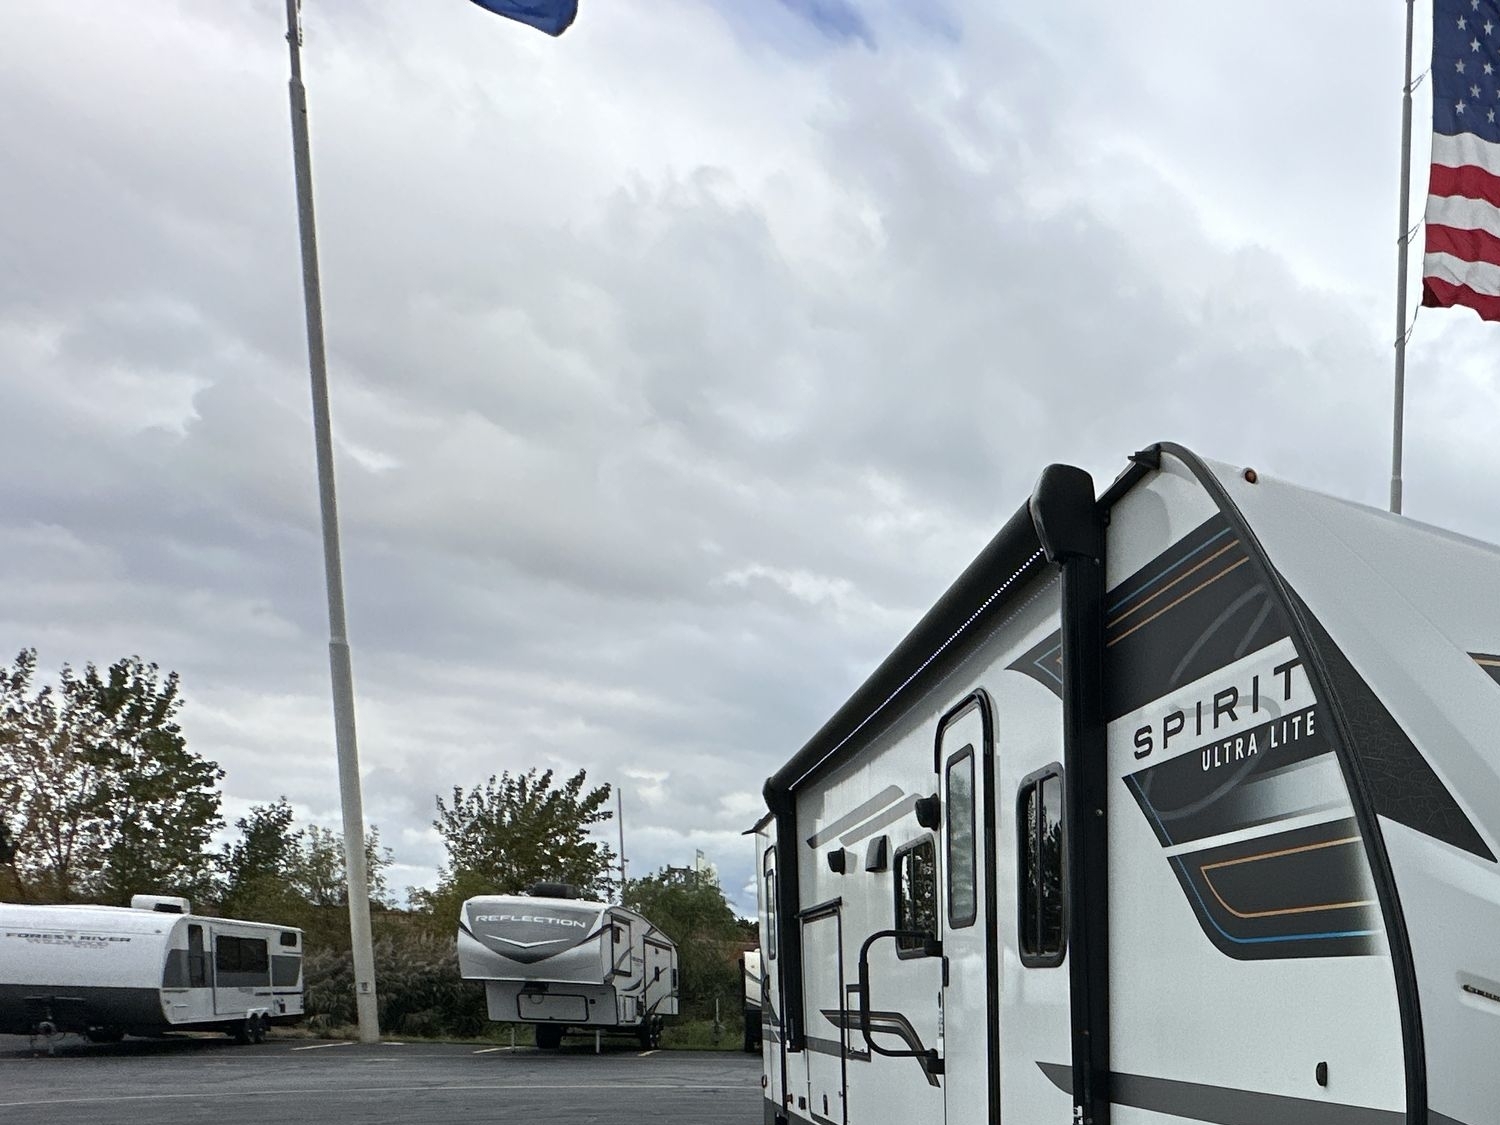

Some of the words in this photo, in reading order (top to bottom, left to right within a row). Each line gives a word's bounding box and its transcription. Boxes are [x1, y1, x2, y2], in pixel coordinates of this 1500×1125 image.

[1134, 657, 1302, 760] SPIRIT
[1201, 733, 1258, 772] ULTRA
[1270, 711, 1315, 749] LITE
[6, 932, 76, 940] FOREST
[80, 935, 132, 943] RIVER
[475, 914, 586, 929] REFLECTION
